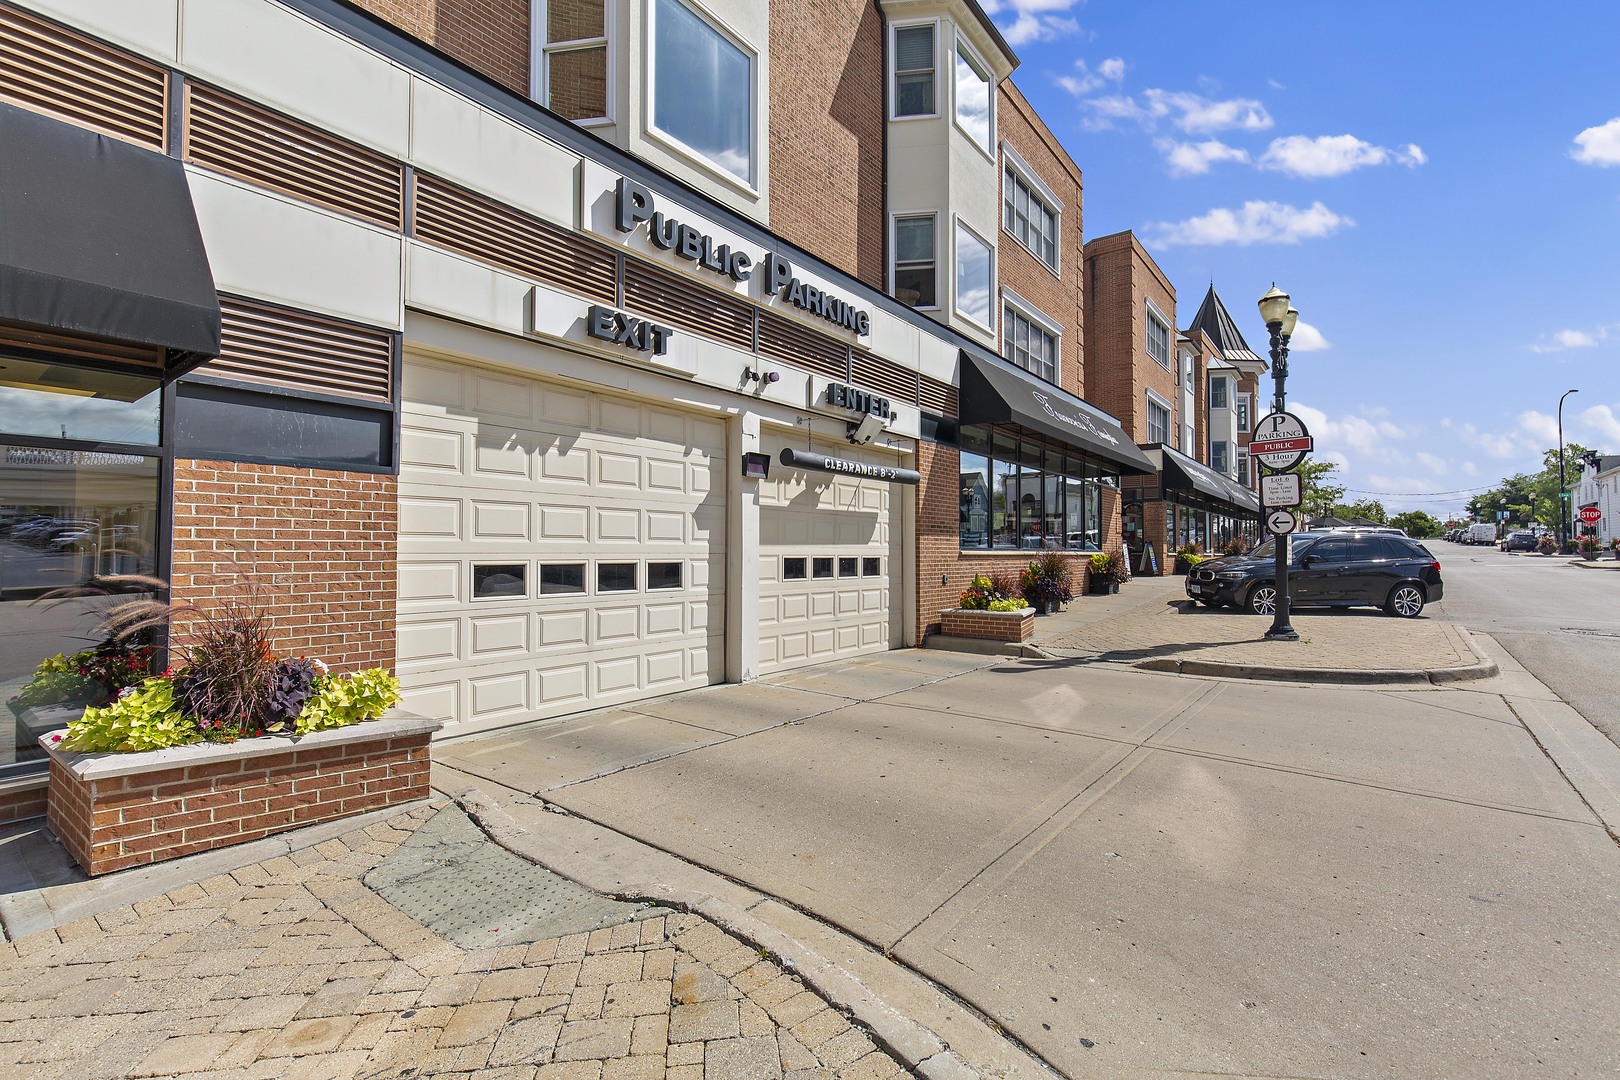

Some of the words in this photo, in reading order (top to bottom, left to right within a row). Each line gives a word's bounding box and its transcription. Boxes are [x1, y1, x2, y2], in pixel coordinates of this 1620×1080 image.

[616, 176, 752, 283] PUBLIC
[764, 252, 870, 337] PARKING
[588, 305, 673, 356] EXIT
[828, 383, 890, 419] ENTER
[1271, 416, 1286, 432] P
[1258, 430, 1301, 440] PARKING
[1264, 442, 1294, 450] PUBLIC
[825, 458, 878, 476] CLEARANCE
